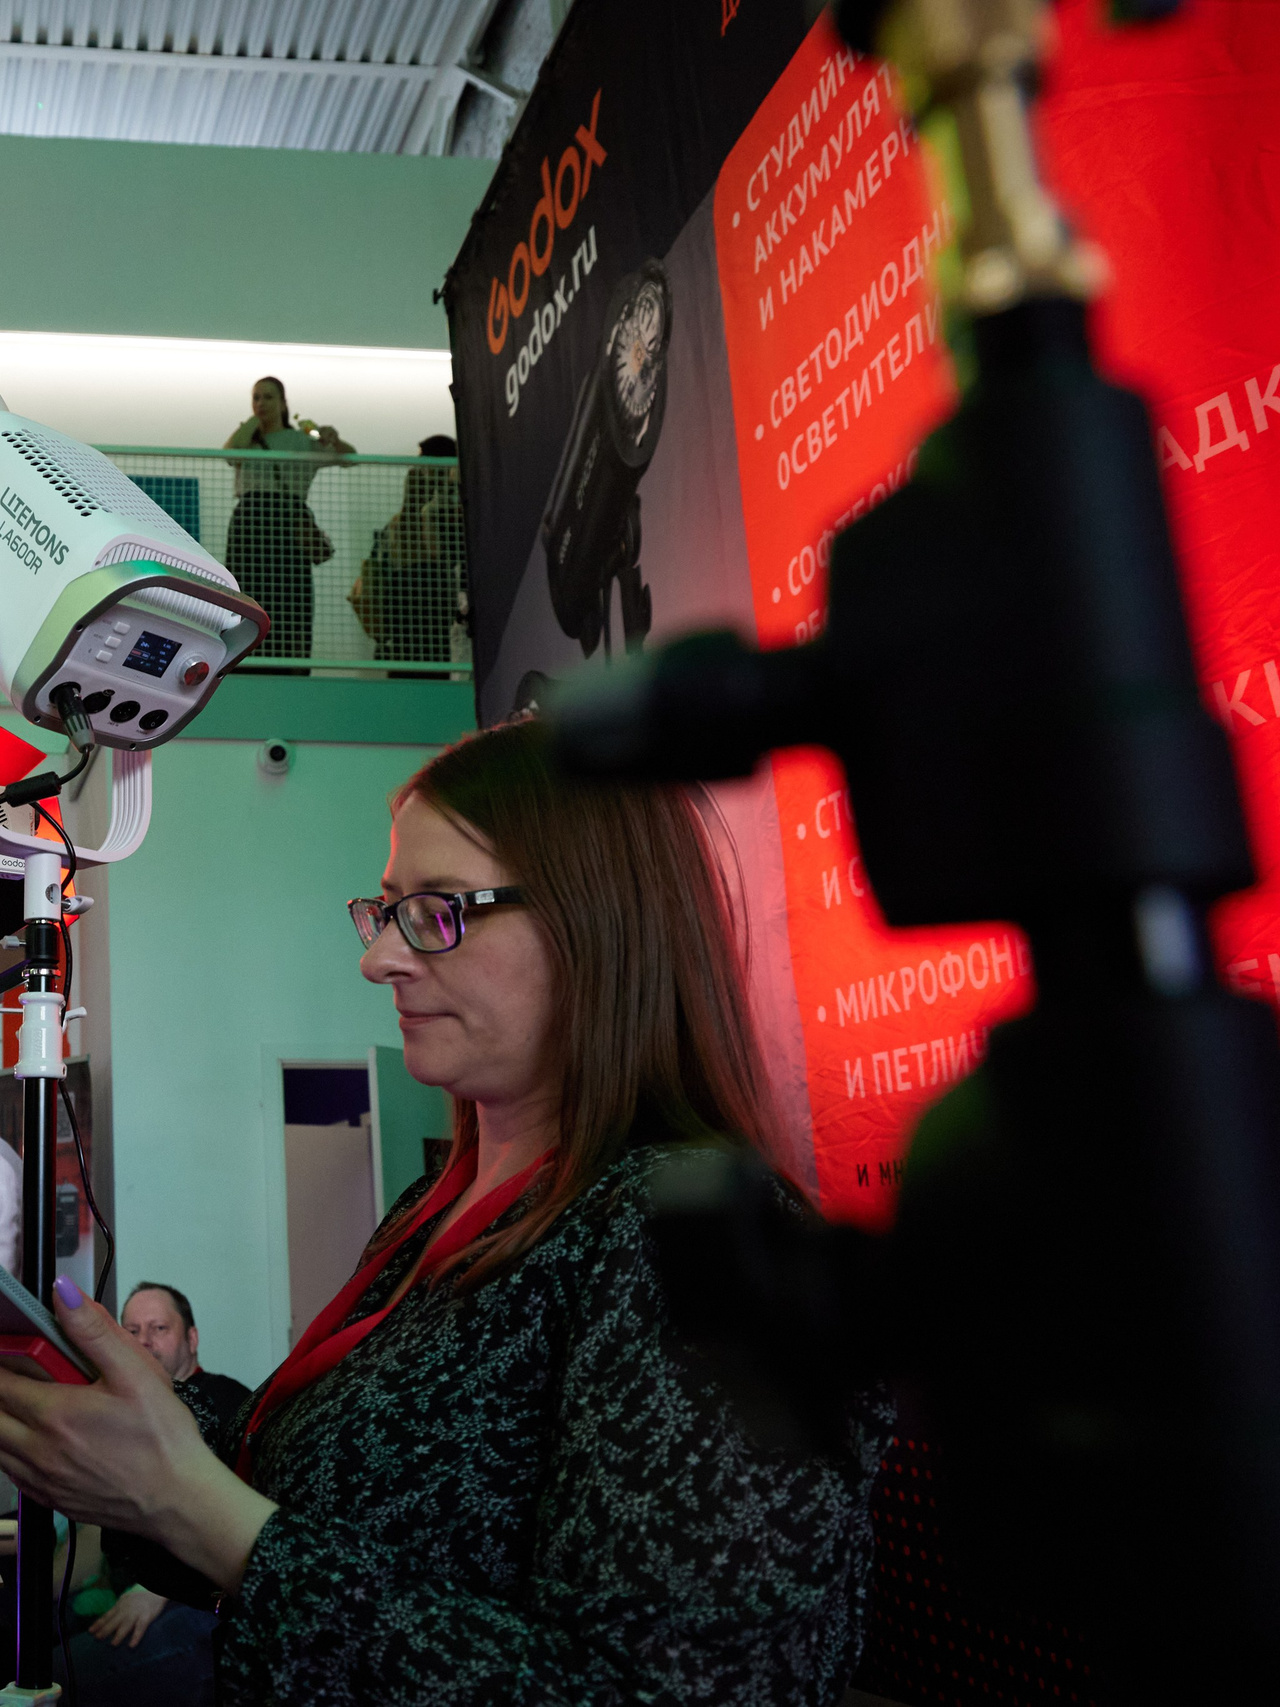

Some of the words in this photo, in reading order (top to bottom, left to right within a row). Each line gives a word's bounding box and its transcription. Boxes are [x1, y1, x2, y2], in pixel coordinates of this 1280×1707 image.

[746, 42, 866, 212] СТУДИЙН
[486, 87, 608, 356] Godox
[505, 225, 598, 418] godox.ru
[759, 286, 775, 332] И
[0, 486, 70, 566] LITEMONS
[823, 866, 842, 910] И
[845, 1059, 867, 1099] И
[857, 1163, 870, 1188] И
